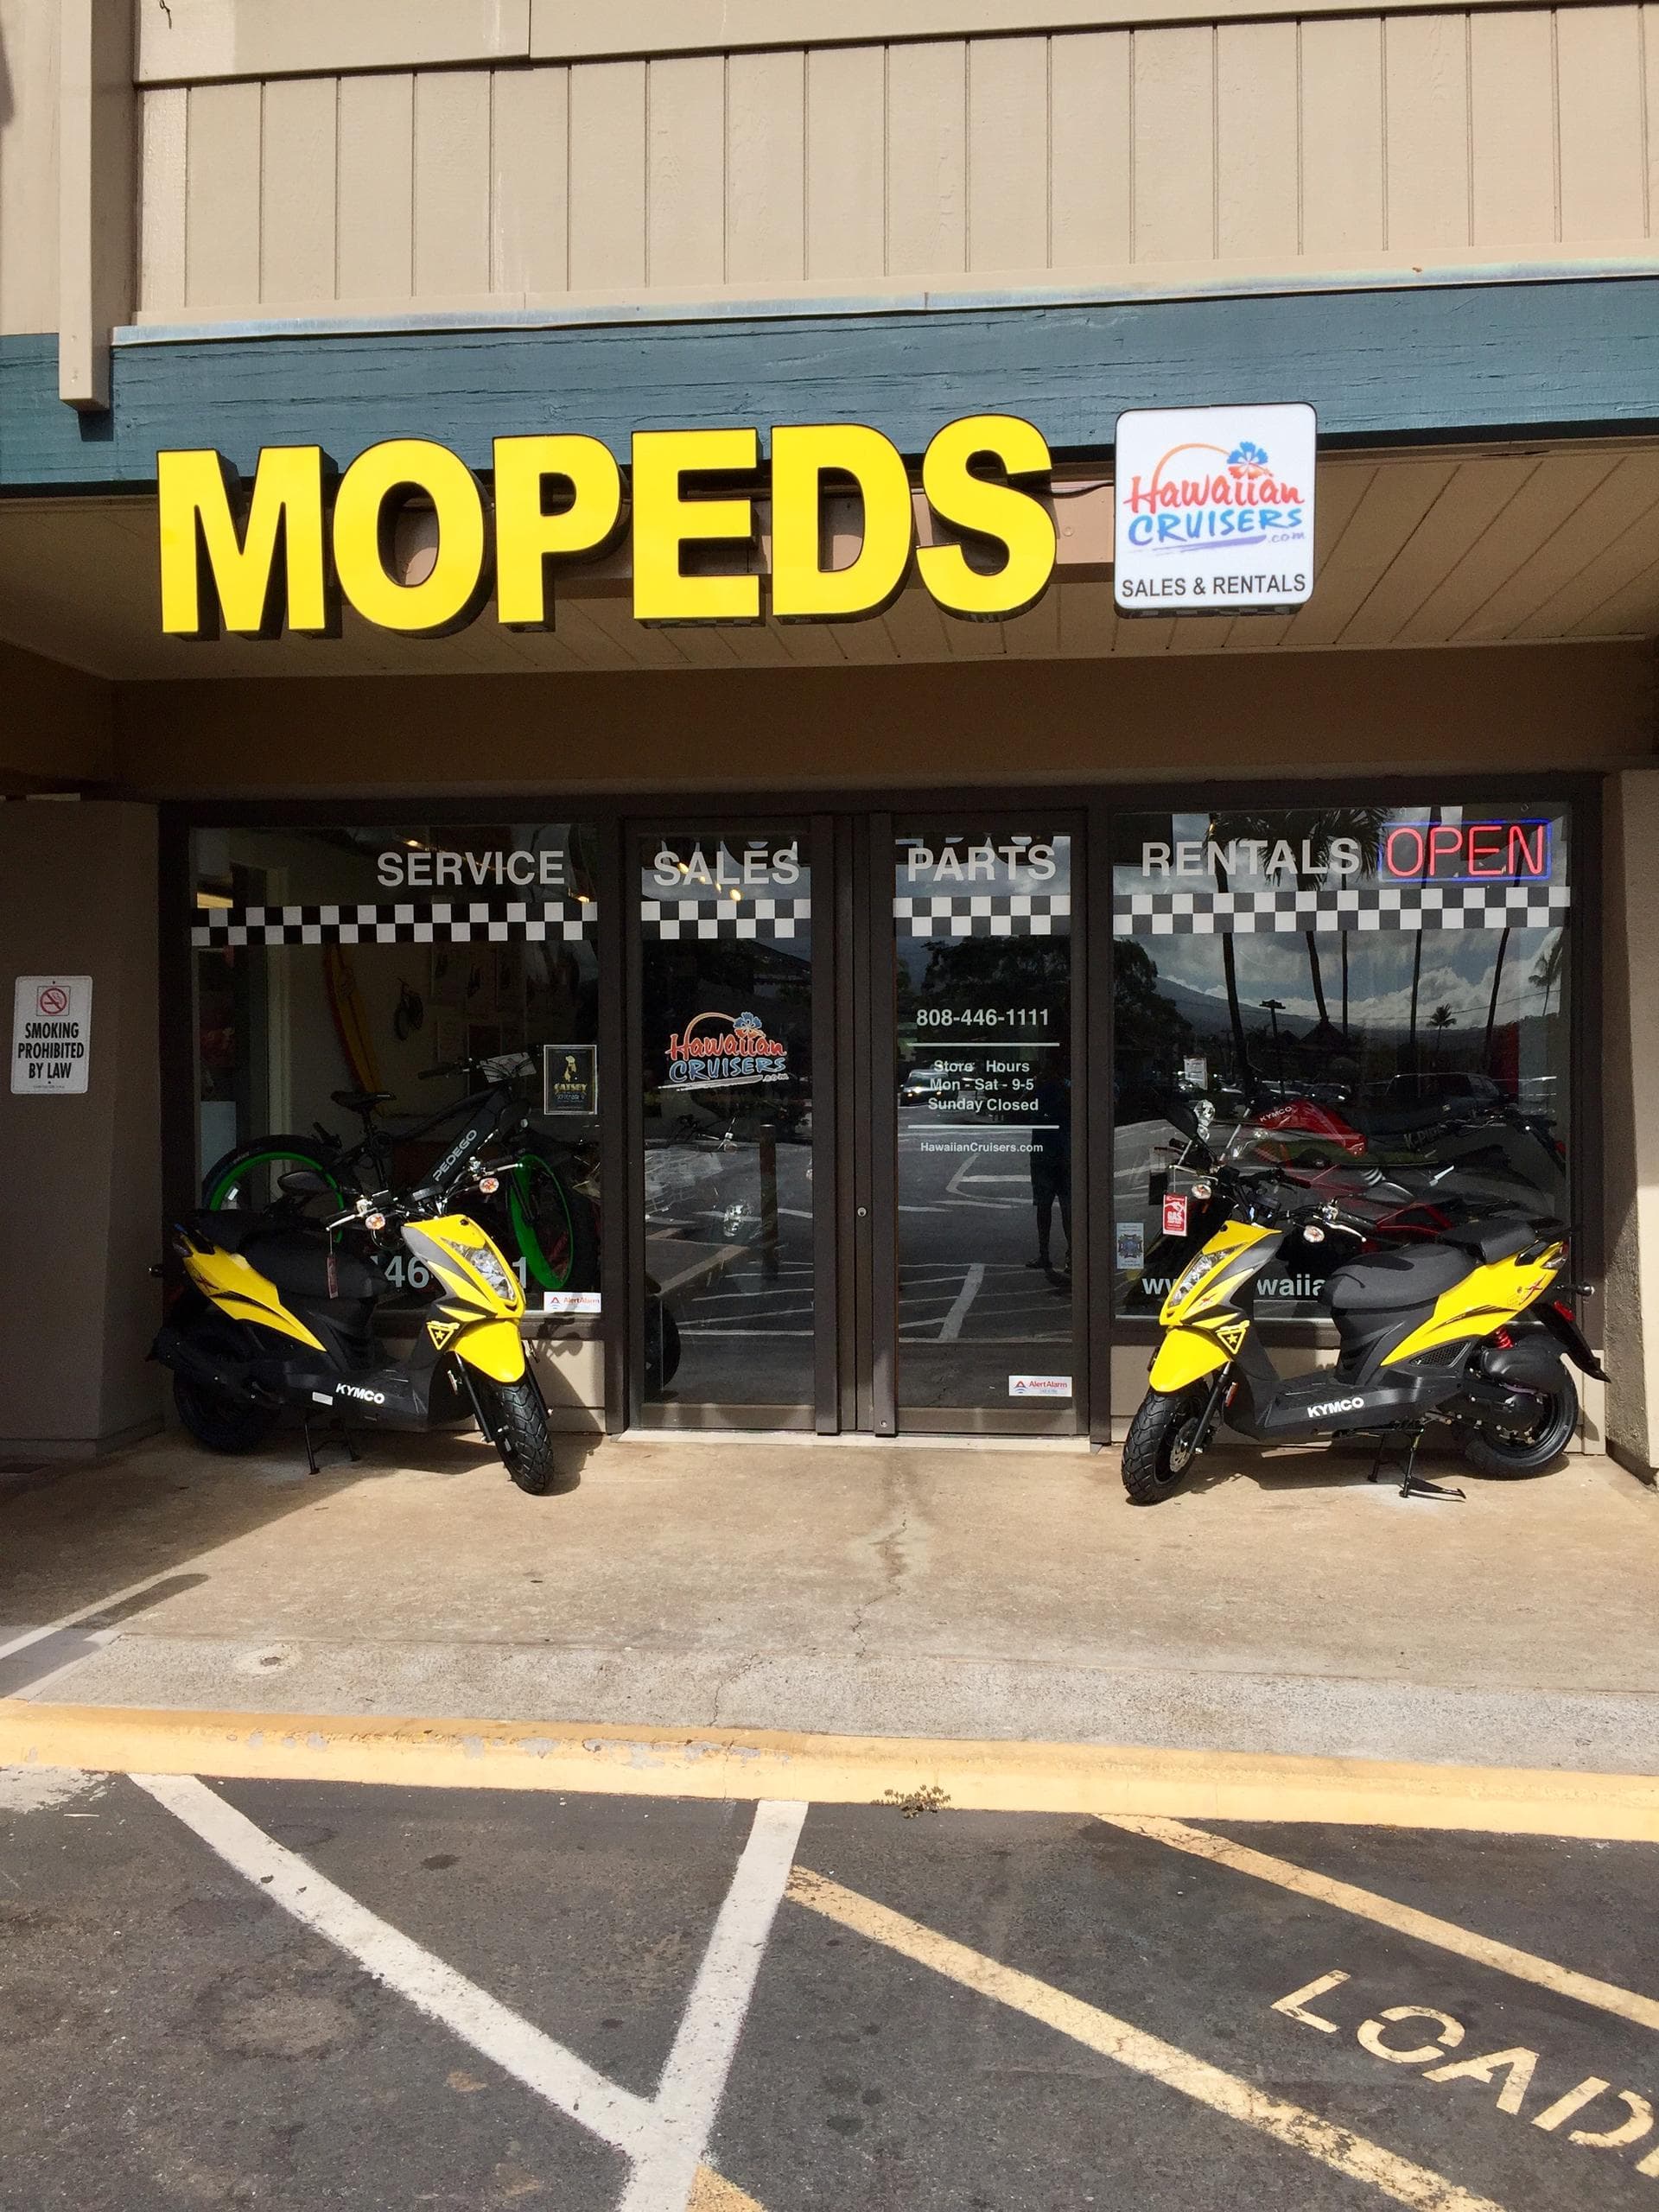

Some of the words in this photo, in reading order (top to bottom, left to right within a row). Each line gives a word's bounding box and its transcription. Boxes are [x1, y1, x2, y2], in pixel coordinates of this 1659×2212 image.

[1123, 473, 1306, 515] Hawaiian
[156, 413, 1057, 634] MOPEDS
[1128, 508, 1303, 546] CRUISERS
[1122, 578, 1186, 598] SALES
[1193, 576, 1206, 595] &
[1213, 573, 1306, 594] RENTALS
[907, 844, 1056, 882] PARTS
[1141, 837, 1360, 876] RENTALS
[1386, 825, 1544, 877] OPEN
[377, 849, 564, 887] SERVICE
[653, 849, 800, 886] SALES
[916, 1008, 1049, 1027] 808-446-1111
[24, 1022, 79, 1039] SMOKING
[17, 1042, 85, 1059] PROHIBITED
[664, 1033, 788, 1061] Hawaiian
[29, 1062, 43, 1079] BY
[47, 1062, 72, 1079] LAW
[669, 1056, 786, 1084] CRUISERS
[933, 1059, 974, 1073] Store
[986, 1059, 1030, 1073] Hours
[930, 1078, 961, 1091] Mon
[975, 1077, 998, 1091] Sat
[1012, 1078, 1034, 1090] 9-5
[928, 1097, 983, 1113] Sunday
[987, 1098, 1039, 1111] Closed
[1259, 1106, 1293, 1122] KYMCO
[432, 1128, 478, 1182] PEDEGO
[920, 1141, 1044, 1153] HawaiianCruisers.com
[335, 1382, 385, 1405] KYMCO
[1028, 1380, 1068, 1389] AlertAlarm
[1306, 1396, 1365, 1419] KYMCO
[1270, 1969, 1659, 2177] LOAD
